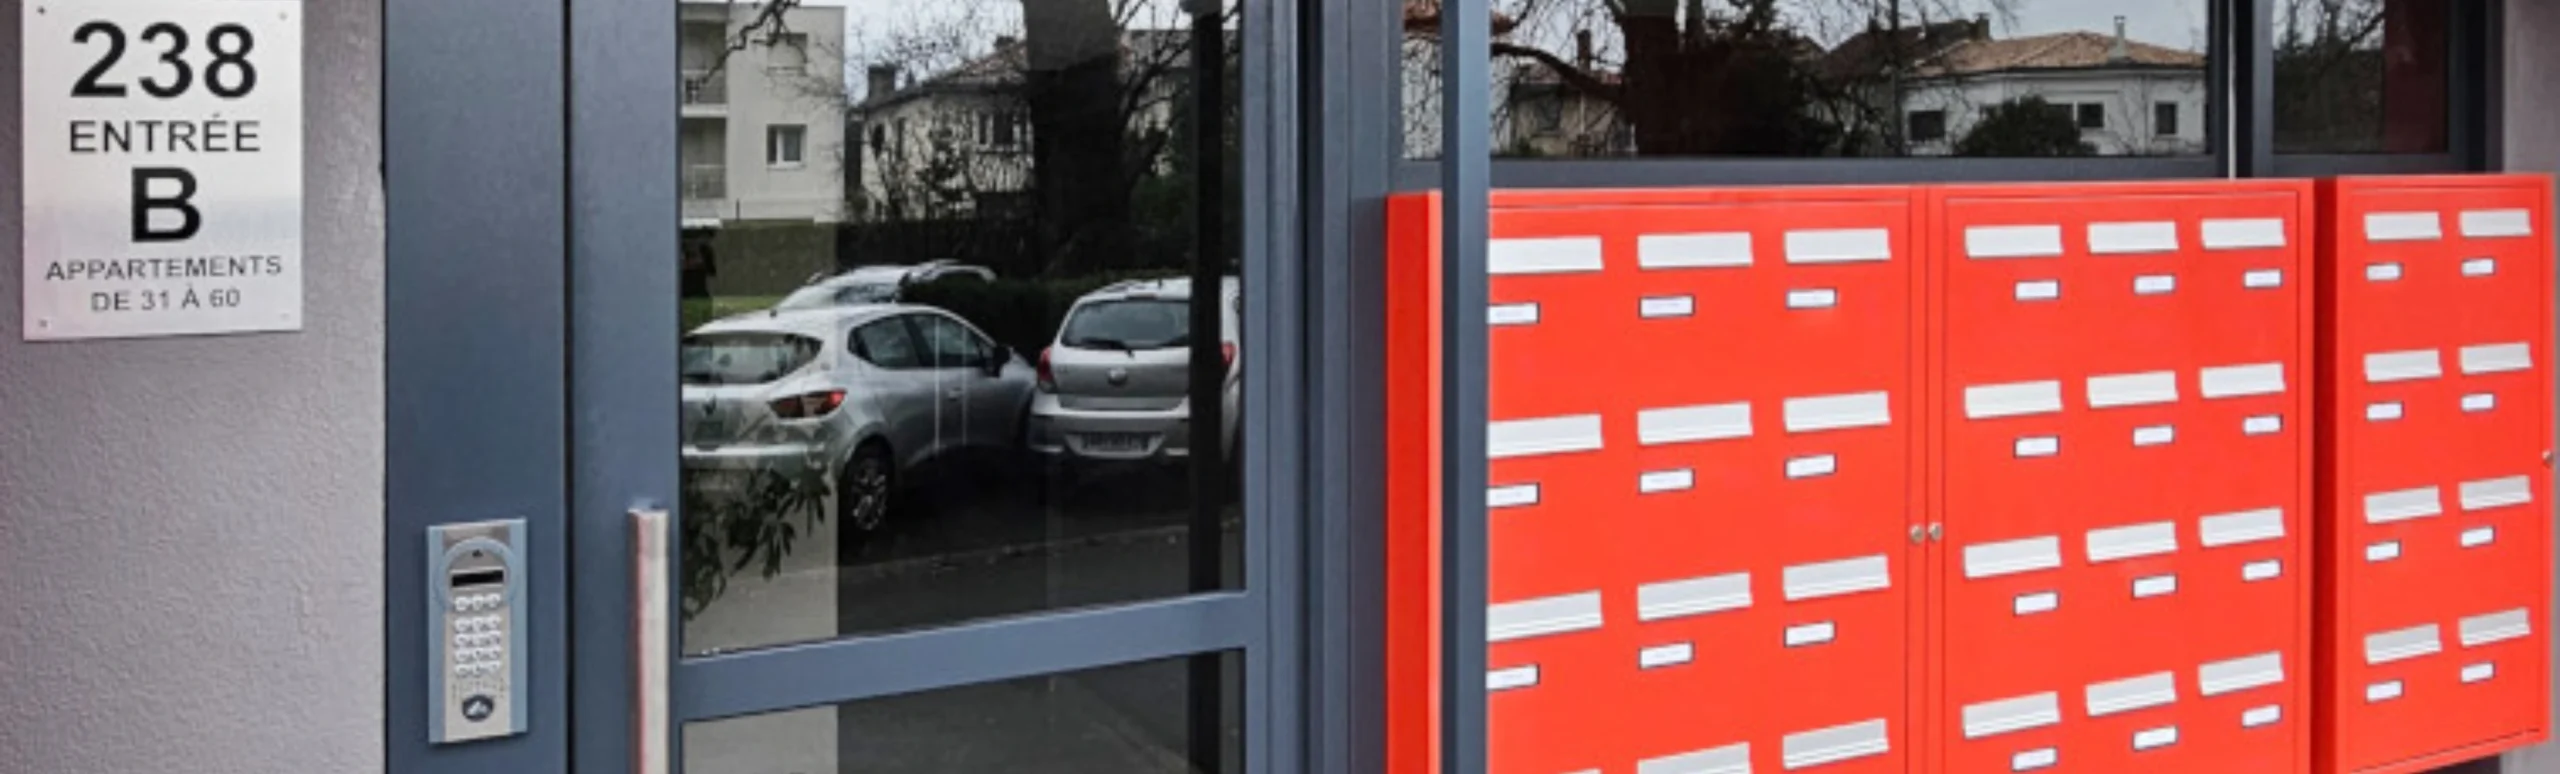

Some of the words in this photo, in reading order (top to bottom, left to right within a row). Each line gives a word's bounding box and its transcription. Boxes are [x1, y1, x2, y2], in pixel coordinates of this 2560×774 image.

[71, 21, 256, 99] 238
[69, 112, 261, 153] ENTRÉE
[131, 167, 202, 243] B
[45, 255, 283, 281] APPARTEMENTS
[91, 291, 130, 312] DE
[141, 290, 170, 310] 31
[209, 288, 241, 308] 60
